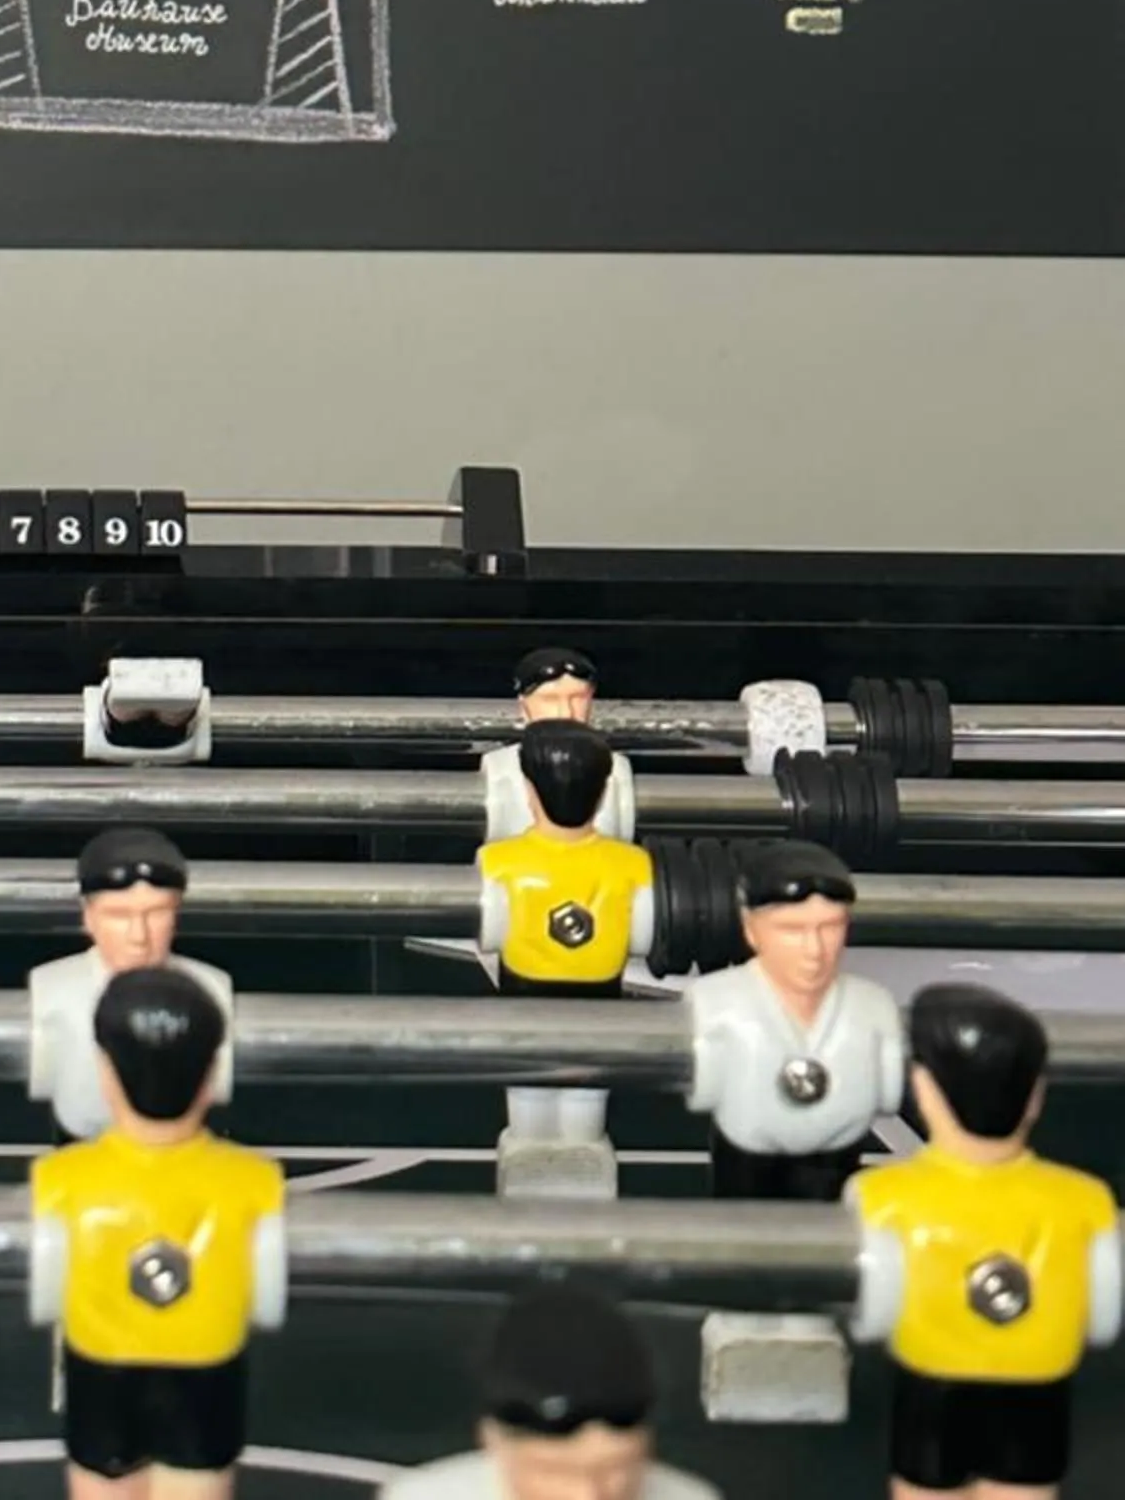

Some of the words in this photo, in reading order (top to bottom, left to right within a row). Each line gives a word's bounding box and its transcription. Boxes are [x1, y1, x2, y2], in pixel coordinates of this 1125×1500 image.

[85, 21, 210, 56] Museum
[11, 515, 34, 545] 7
[57, 515, 83, 545] 8
[104, 517, 130, 546] 9
[146, 517, 185, 546] 10
